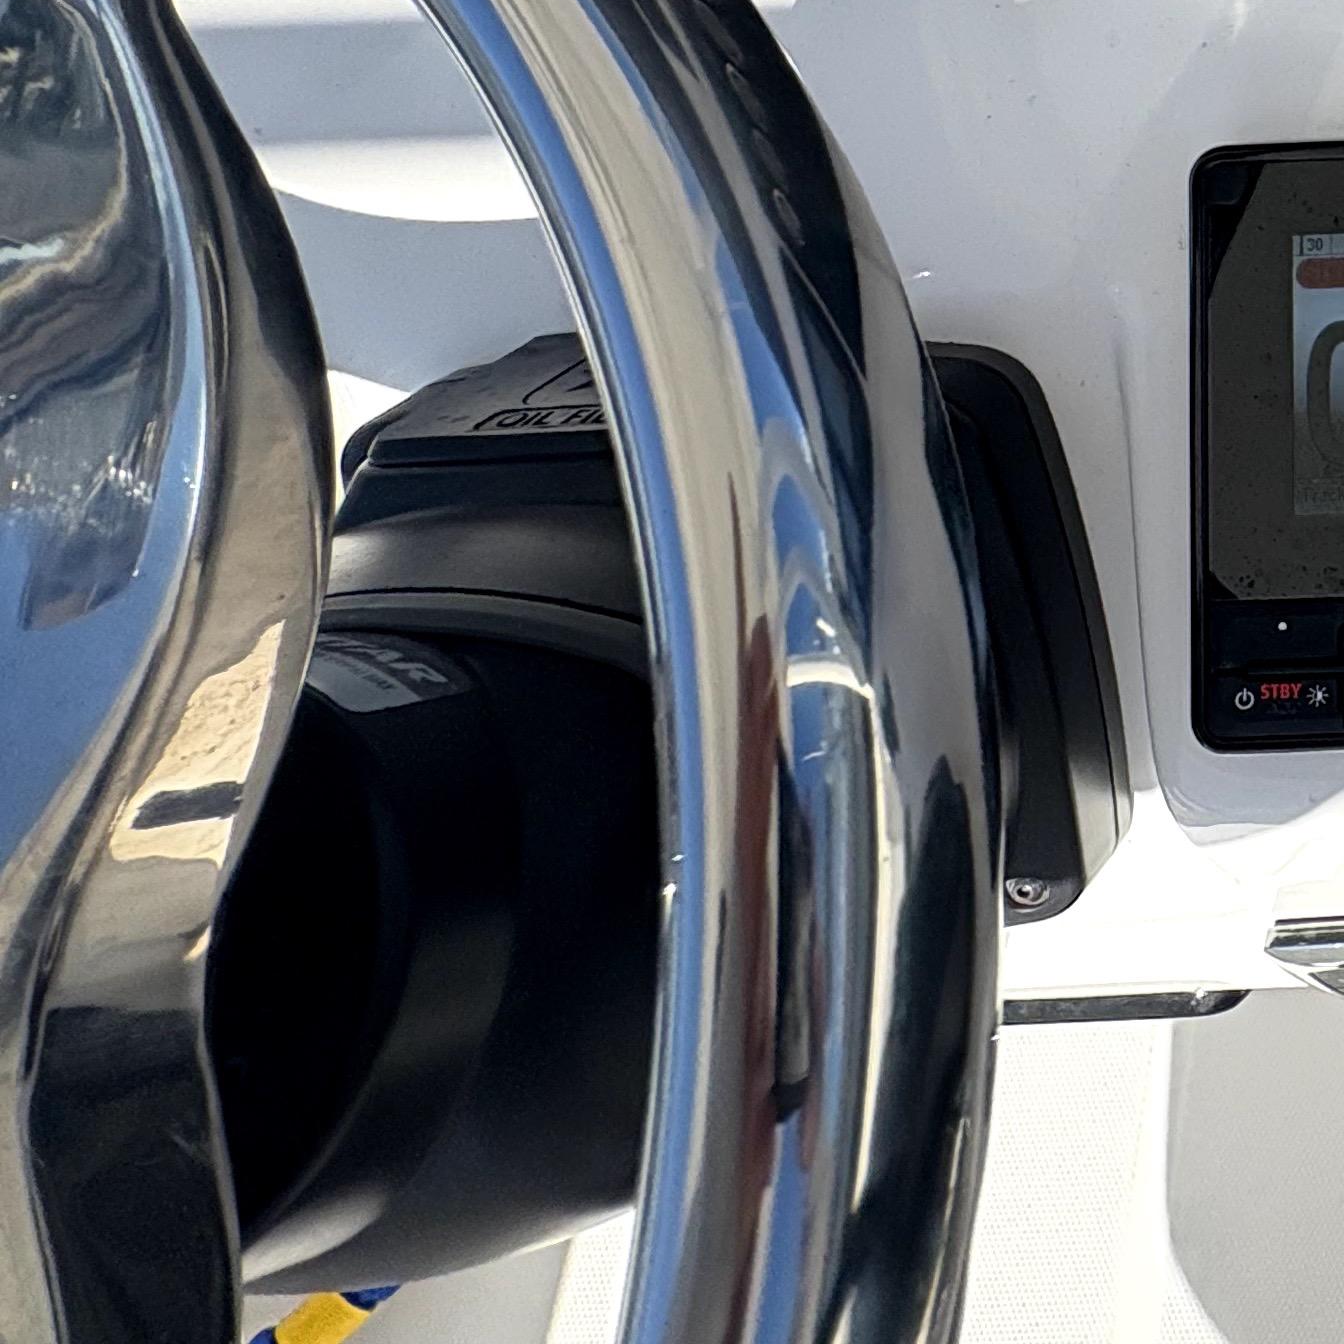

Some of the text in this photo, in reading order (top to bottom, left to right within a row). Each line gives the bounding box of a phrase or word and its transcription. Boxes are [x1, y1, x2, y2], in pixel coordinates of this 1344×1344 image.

[1306, 237, 1323, 251] 30
[497, 410, 555, 427] OIL
[1261, 684, 1300, 698] STBY
